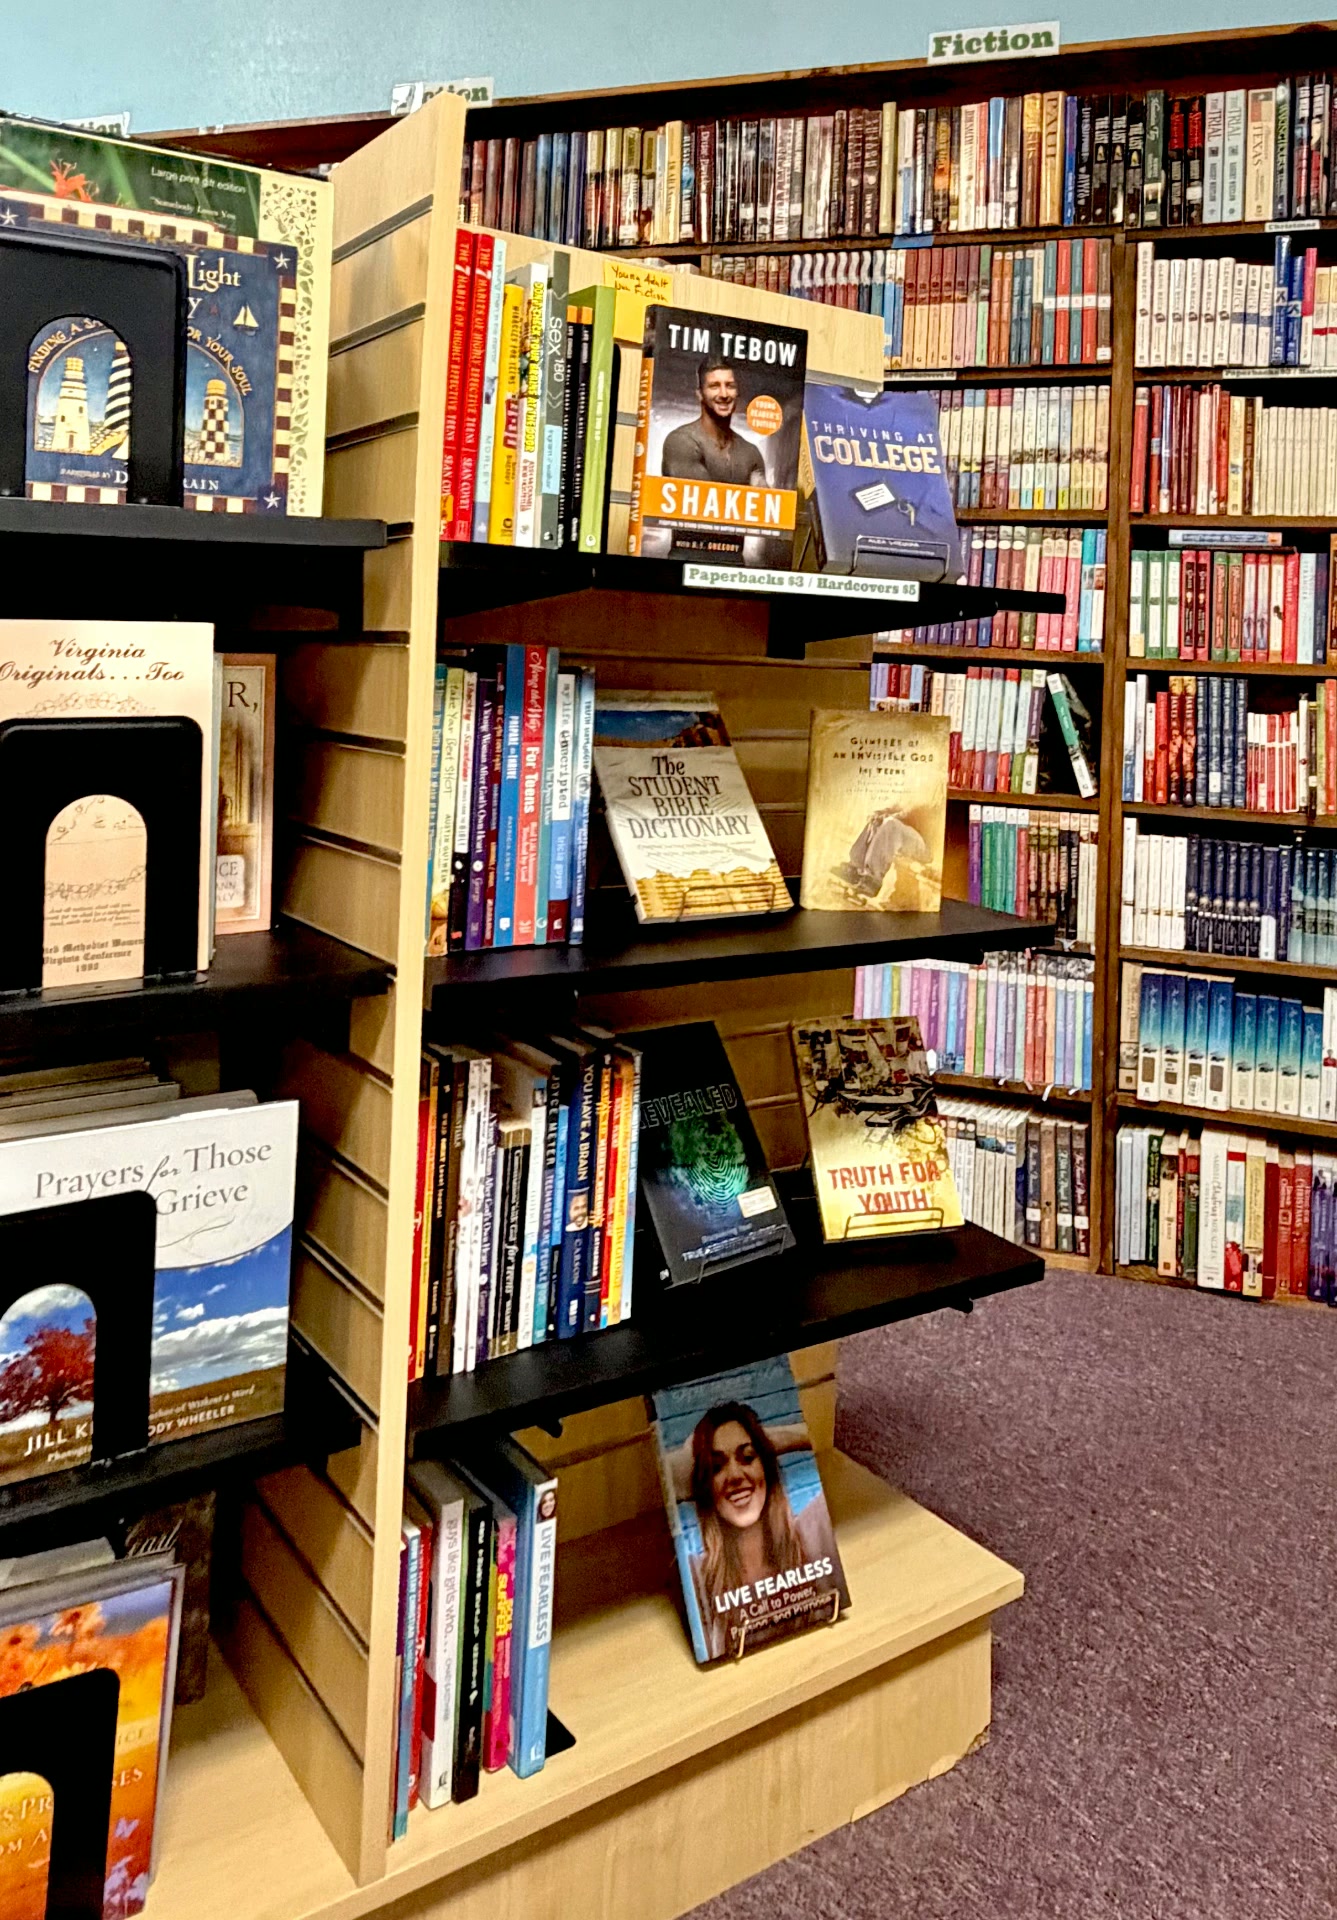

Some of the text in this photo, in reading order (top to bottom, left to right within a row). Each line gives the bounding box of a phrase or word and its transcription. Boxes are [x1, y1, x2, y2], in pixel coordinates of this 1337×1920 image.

[932, 30, 1054, 57] Fiction
[1207, 110, 1222, 142] TRIAL
[1227, 109, 1242, 142] TRIAL
[1252, 125, 1263, 166] TEXAS
[458, 243, 470, 262] THE
[479, 248, 492, 266] THE
[186, 254, 242, 293] Light
[454, 264, 471, 276] 7
[475, 269, 491, 279] 7
[611, 265, 670, 288] Young Adult
[456, 274, 469, 311] HABITS
[473, 279, 488, 315] HABITS
[454, 314, 464, 327] OF
[472, 318, 484, 331] OF
[547, 316, 563, 356] sex
[27, 331, 66, 373] FINDING
[450, 330, 463, 362] HIGHLY
[470, 333, 484, 365] HIGHLY
[669, 324, 797, 367] TIM TEBOW
[204, 336, 252, 396] YOUR SOUL
[553, 358, 565, 382] 180
[637, 369, 650, 428] SHAKEN
[812, 420, 934, 444] THRIVING AT
[481, 435, 493, 487] MORLEY
[814, 435, 941, 474] COLLEGE
[630, 471, 643, 522] TEBOW
[660, 482, 781, 525] SHAKEN
[688, 568, 785, 587] Paperbacks
[787, 576, 805, 588] $3
[816, 577, 900, 595] Hardcovers
[902, 583, 917, 596] $5
[49, 638, 147, 665] Virginia
[479, 708, 493, 732] Young
[480, 734, 493, 763] Woman
[477, 764, 489, 785] After
[523, 746, 541, 814] For Teens
[652, 755, 686, 775] The
[877, 767, 906, 776] TEENS
[628, 776, 722, 797] STUDENT
[652, 796, 714, 817] BIBLE
[627, 815, 752, 839] DICTIONARY
[582, 1064, 595, 1092] YOU
[546, 1074, 561, 1166] JOYCE MEYER
[580, 1094, 593, 1128] HAVE
[36, 1141, 273, 1199] Prayers for Those
[577, 1142, 591, 1182] BRAIN
[828, 1161, 940, 1190] TRUTH FOR
[156, 1182, 249, 1216] Grieve
[858, 1188, 930, 1214] YOUTH
[503, 1243, 520, 1263] for
[571, 1238, 583, 1285] CARSON
[177, 1404, 236, 1428] WHEELER
[24, 1430, 67, 1456] JILL
[444, 1517, 460, 1549] guys
[447, 1549, 460, 1574] like
[443, 1575, 458, 1604] girls
[535, 1524, 553, 1642] LIVE FEARLESS
[715, 1557, 833, 1613] LIVE FEARLESS
[495, 1572, 509, 1637] SURFER
[740, 1586, 817, 1619] A Call to Power,
